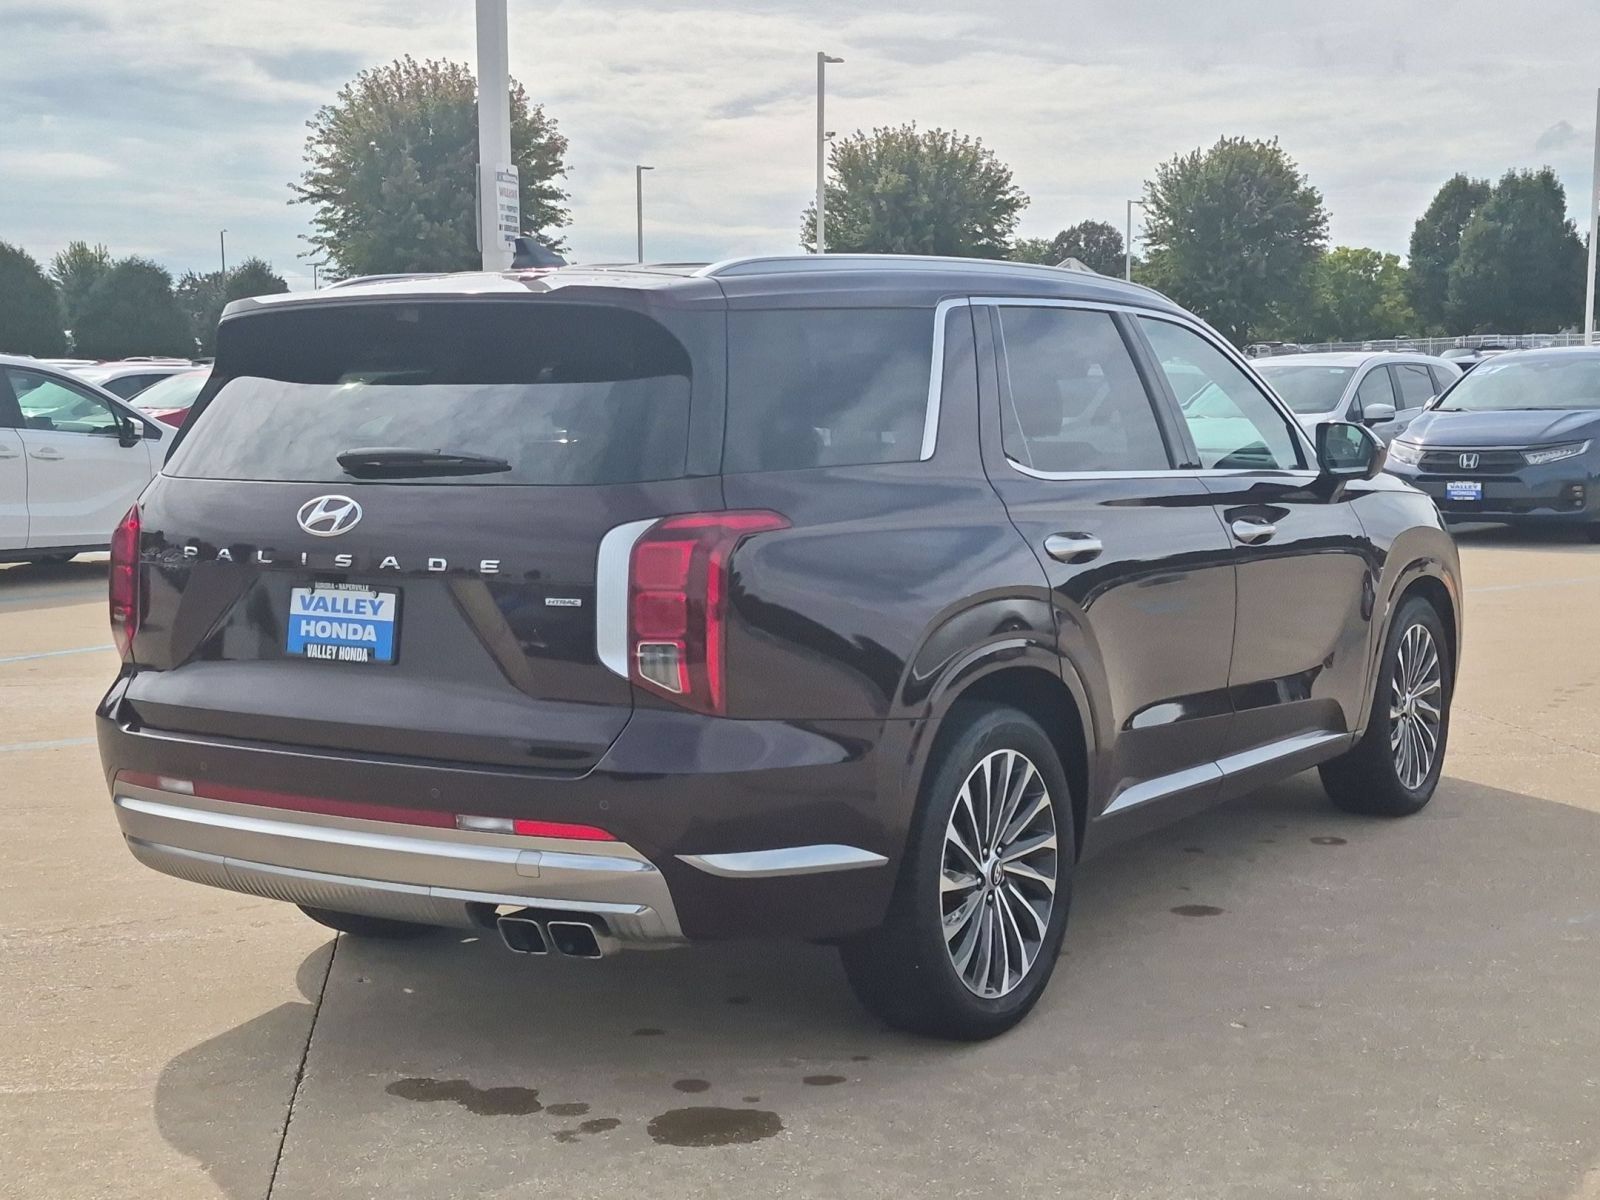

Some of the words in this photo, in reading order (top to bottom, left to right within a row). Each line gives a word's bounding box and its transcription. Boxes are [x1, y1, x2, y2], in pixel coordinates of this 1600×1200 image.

[183, 545, 501, 574] PALISADE
[299, 594, 385, 616] VALLEY
[299, 619, 378, 642] HONDA
[306, 643, 337, 660] VALLEY
[338, 645, 369, 662] HONDA
